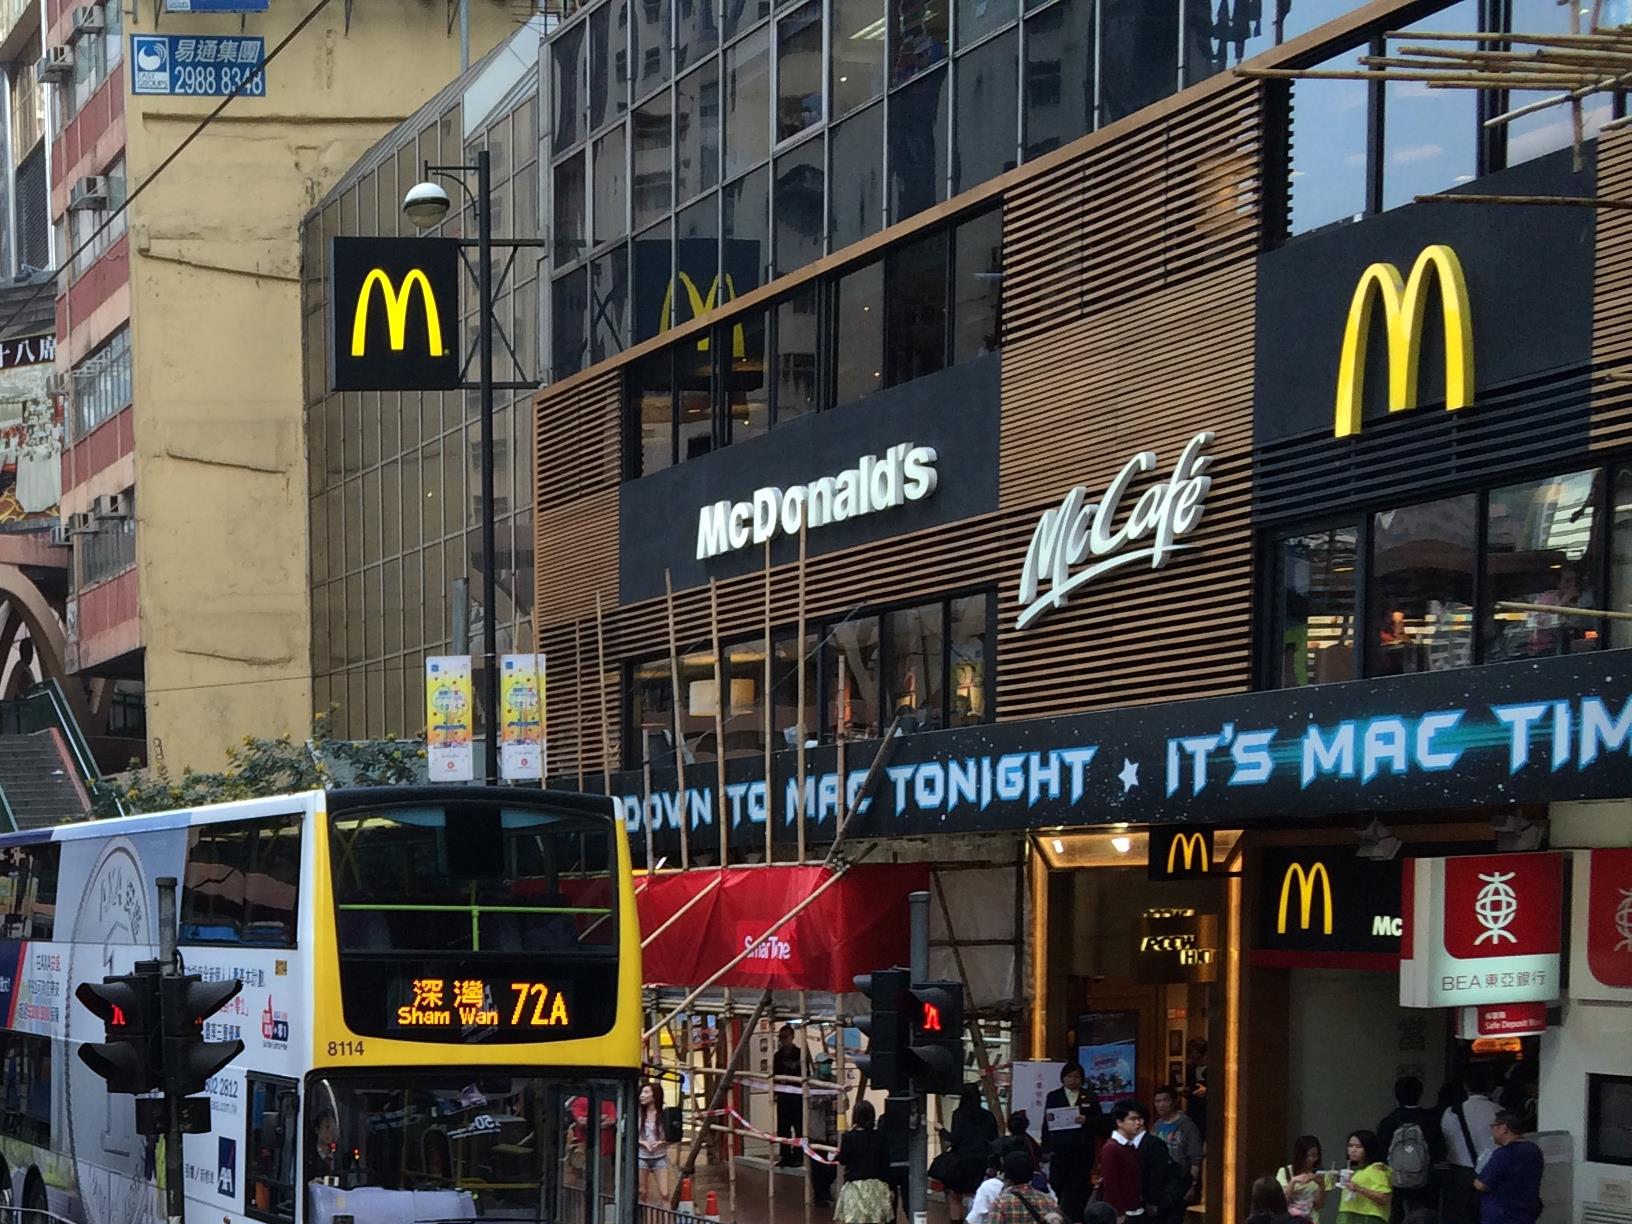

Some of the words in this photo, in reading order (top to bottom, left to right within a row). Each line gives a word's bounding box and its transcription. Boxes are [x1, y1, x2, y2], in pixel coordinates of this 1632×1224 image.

[174, 39, 261, 64] 易通集團
[174, 66, 216, 94] 2988
[696, 441, 939, 561] McDonald's
[1016, 431, 1217, 618] McCafé
[725, 780, 769, 830] TO
[885, 744, 1100, 817] TONIGHT
[1165, 722, 1279, 800] IT'S
[1300, 707, 1468, 791] MAC
[1441, 974, 1483, 992] BEA
[1484, 970, 1547, 989] 東亞銀行
[412, 978, 485, 1009] 深灣
[510, 982, 569, 1026] 72A
[397, 1005, 451, 1026] Sham
[459, 1005, 499, 1026] Wan
[1484, 1021, 1501, 1030] Safe
[1501, 1019, 1529, 1030] Deposit
[327, 1040, 365, 1057] 8114
